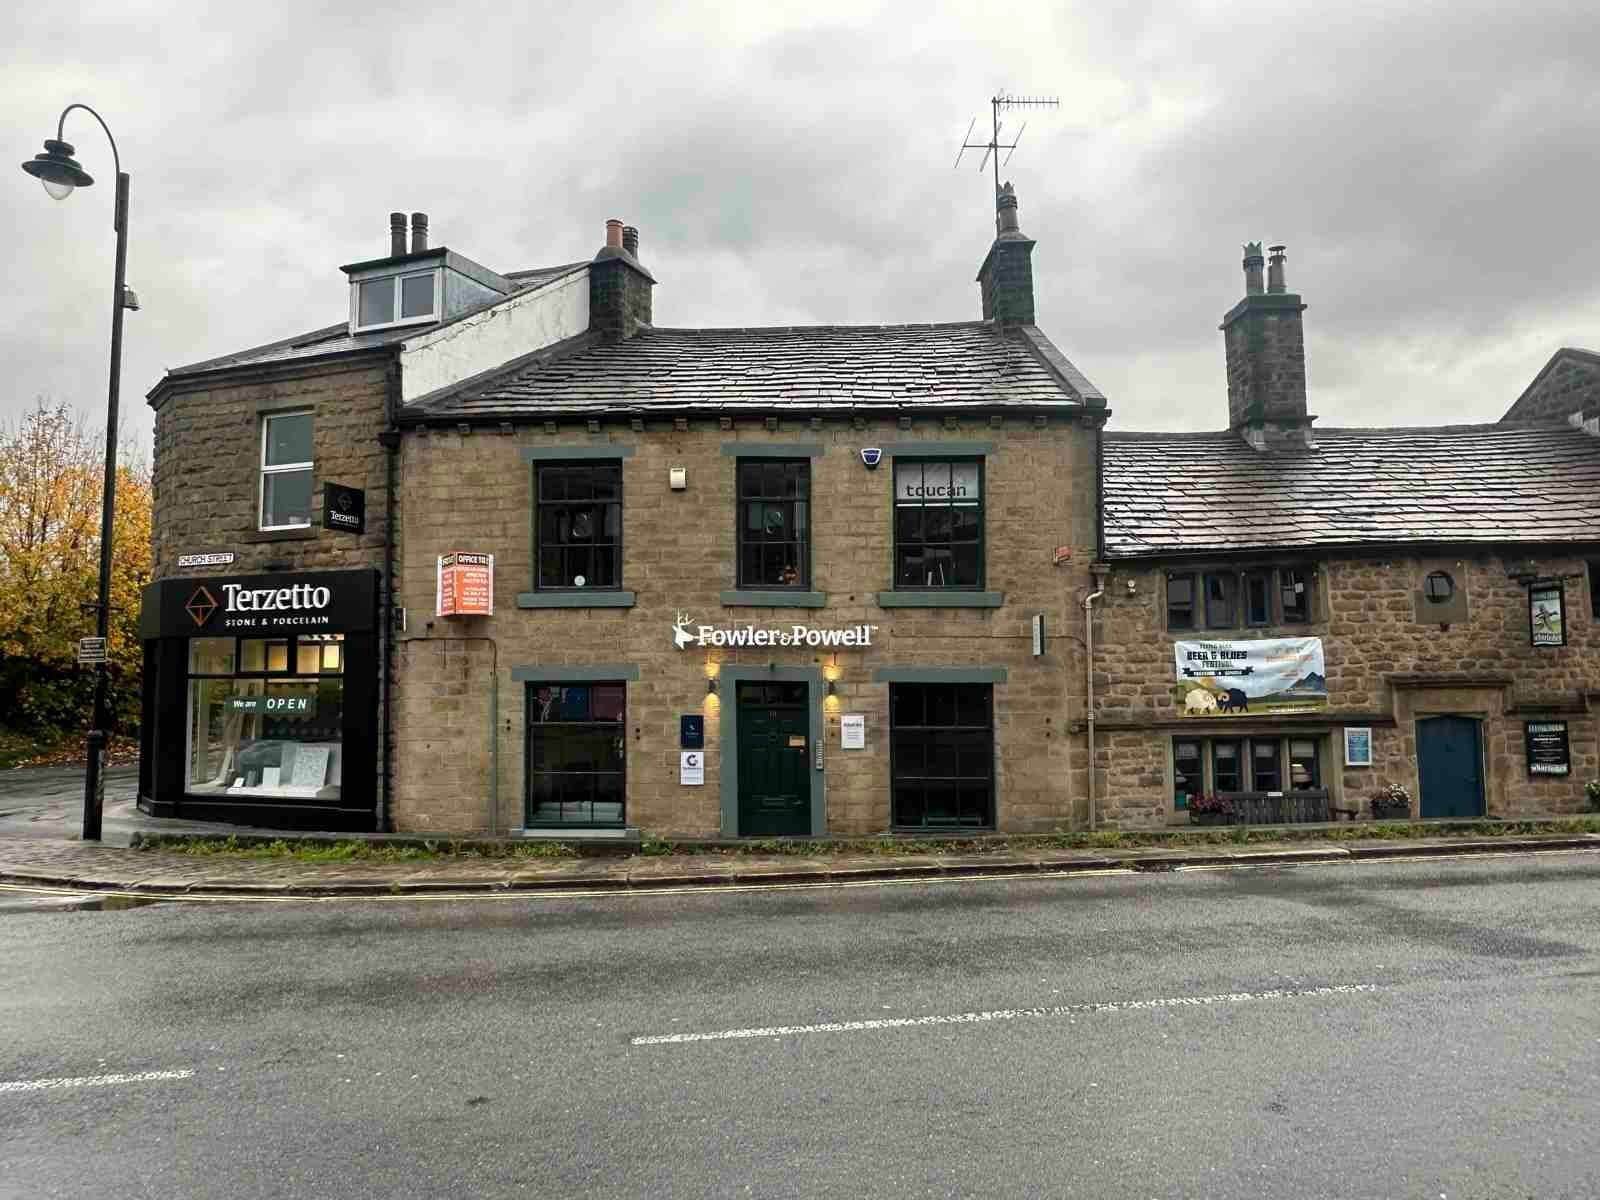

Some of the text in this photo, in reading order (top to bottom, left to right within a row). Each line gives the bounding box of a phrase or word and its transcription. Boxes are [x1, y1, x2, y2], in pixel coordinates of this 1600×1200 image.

[906, 485, 966, 497] toucan
[179, 554, 233, 565] CHURCH STREET
[222, 584, 331, 612] Terzetto
[225, 619, 257, 627] STONE
[273, 617, 329, 625] PORCELAIN
[1187, 651, 1209, 660] BEER
[1220, 650, 1247, 660] BLUES
[233, 700, 244, 708] We
[266, 698, 307, 709] OPEN
